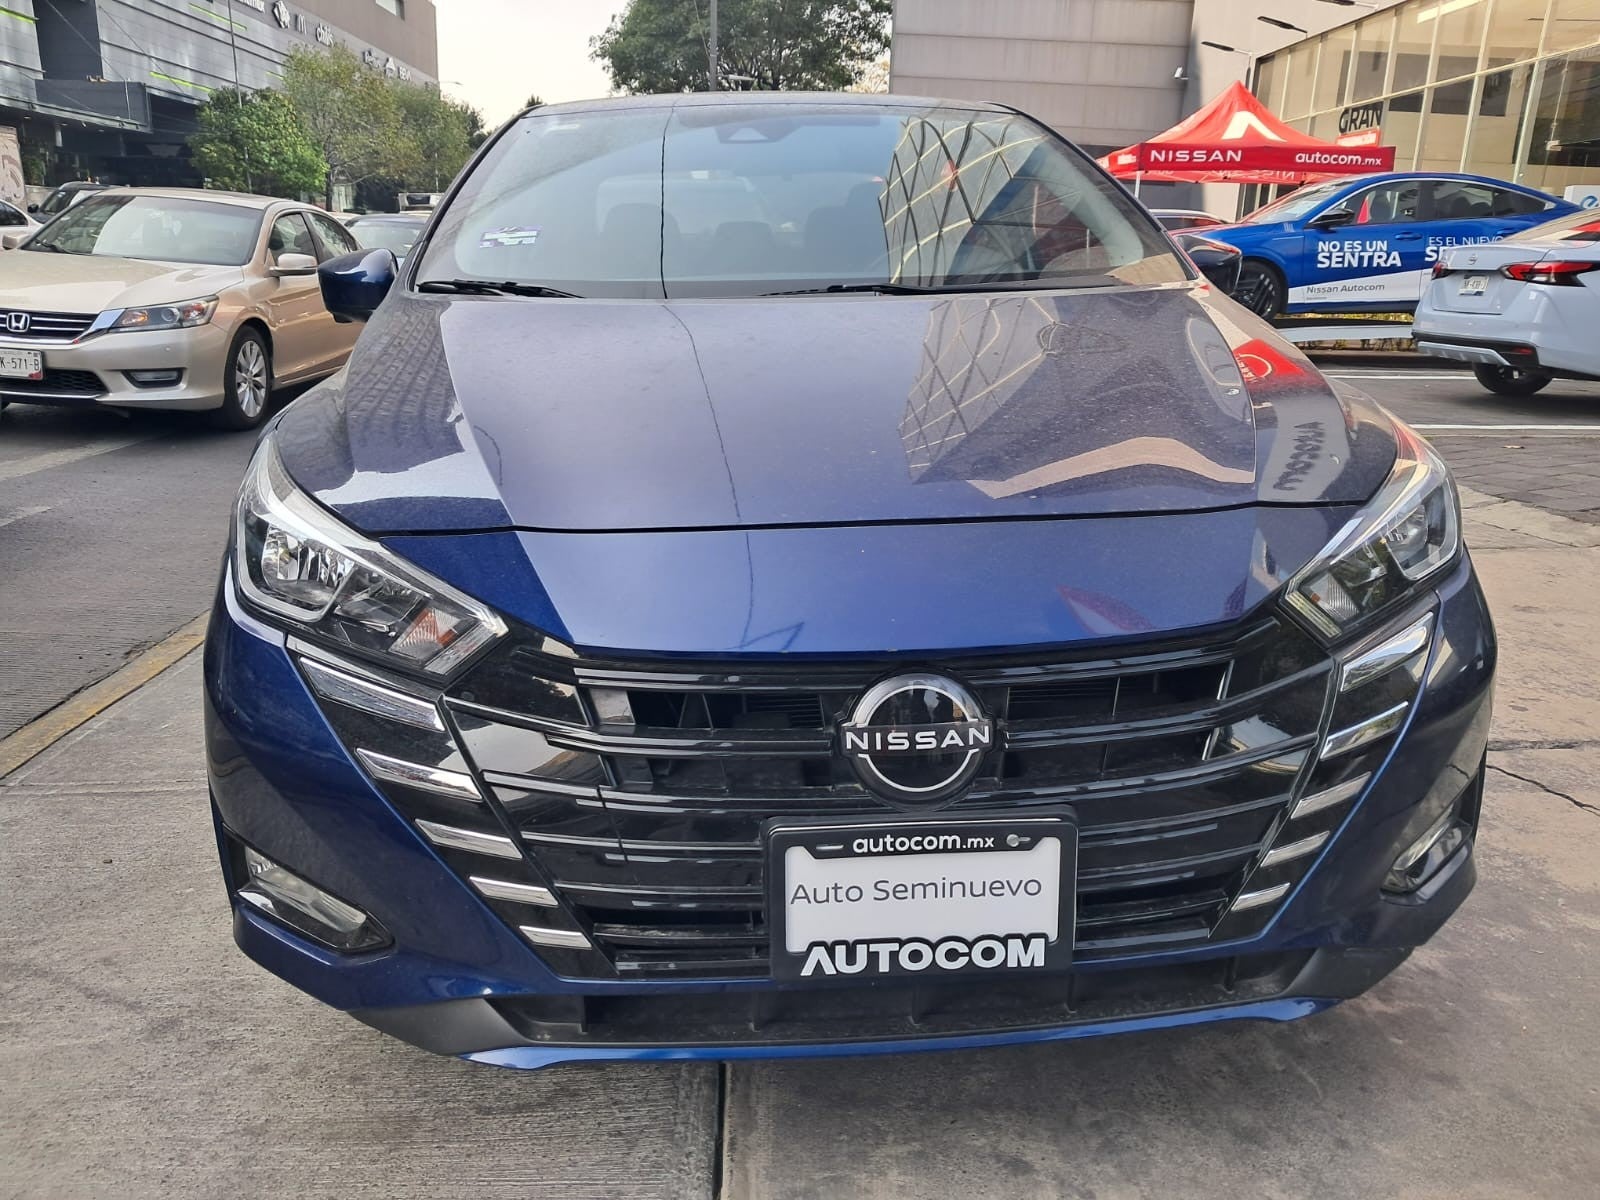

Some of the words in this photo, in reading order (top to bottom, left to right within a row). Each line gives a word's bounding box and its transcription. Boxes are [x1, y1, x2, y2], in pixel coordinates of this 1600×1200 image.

[1339, 106, 1383, 133] GRAN
[1150, 150, 1243, 163] NISSAN
[1295, 151, 1383, 166] autocom.mx
[1318, 241, 1341, 253] NO
[1344, 240, 1363, 253] ES
[1366, 240, 1388, 252] UN
[1429, 236, 1443, 246] ES
[1446, 236, 1457, 246] EL
[1317, 252, 1402, 268] SENTRA
[1306, 286, 1339, 295] Nissan
[1341, 284, 1385, 294] Autocom
[845, 725, 990, 751] NISSAN
[852, 833, 995, 854] autocom.mx
[790, 883, 864, 905] Auto
[873, 877, 1042, 902] Seminuevo
[800, 937, 1046, 977] AUTOCOM
